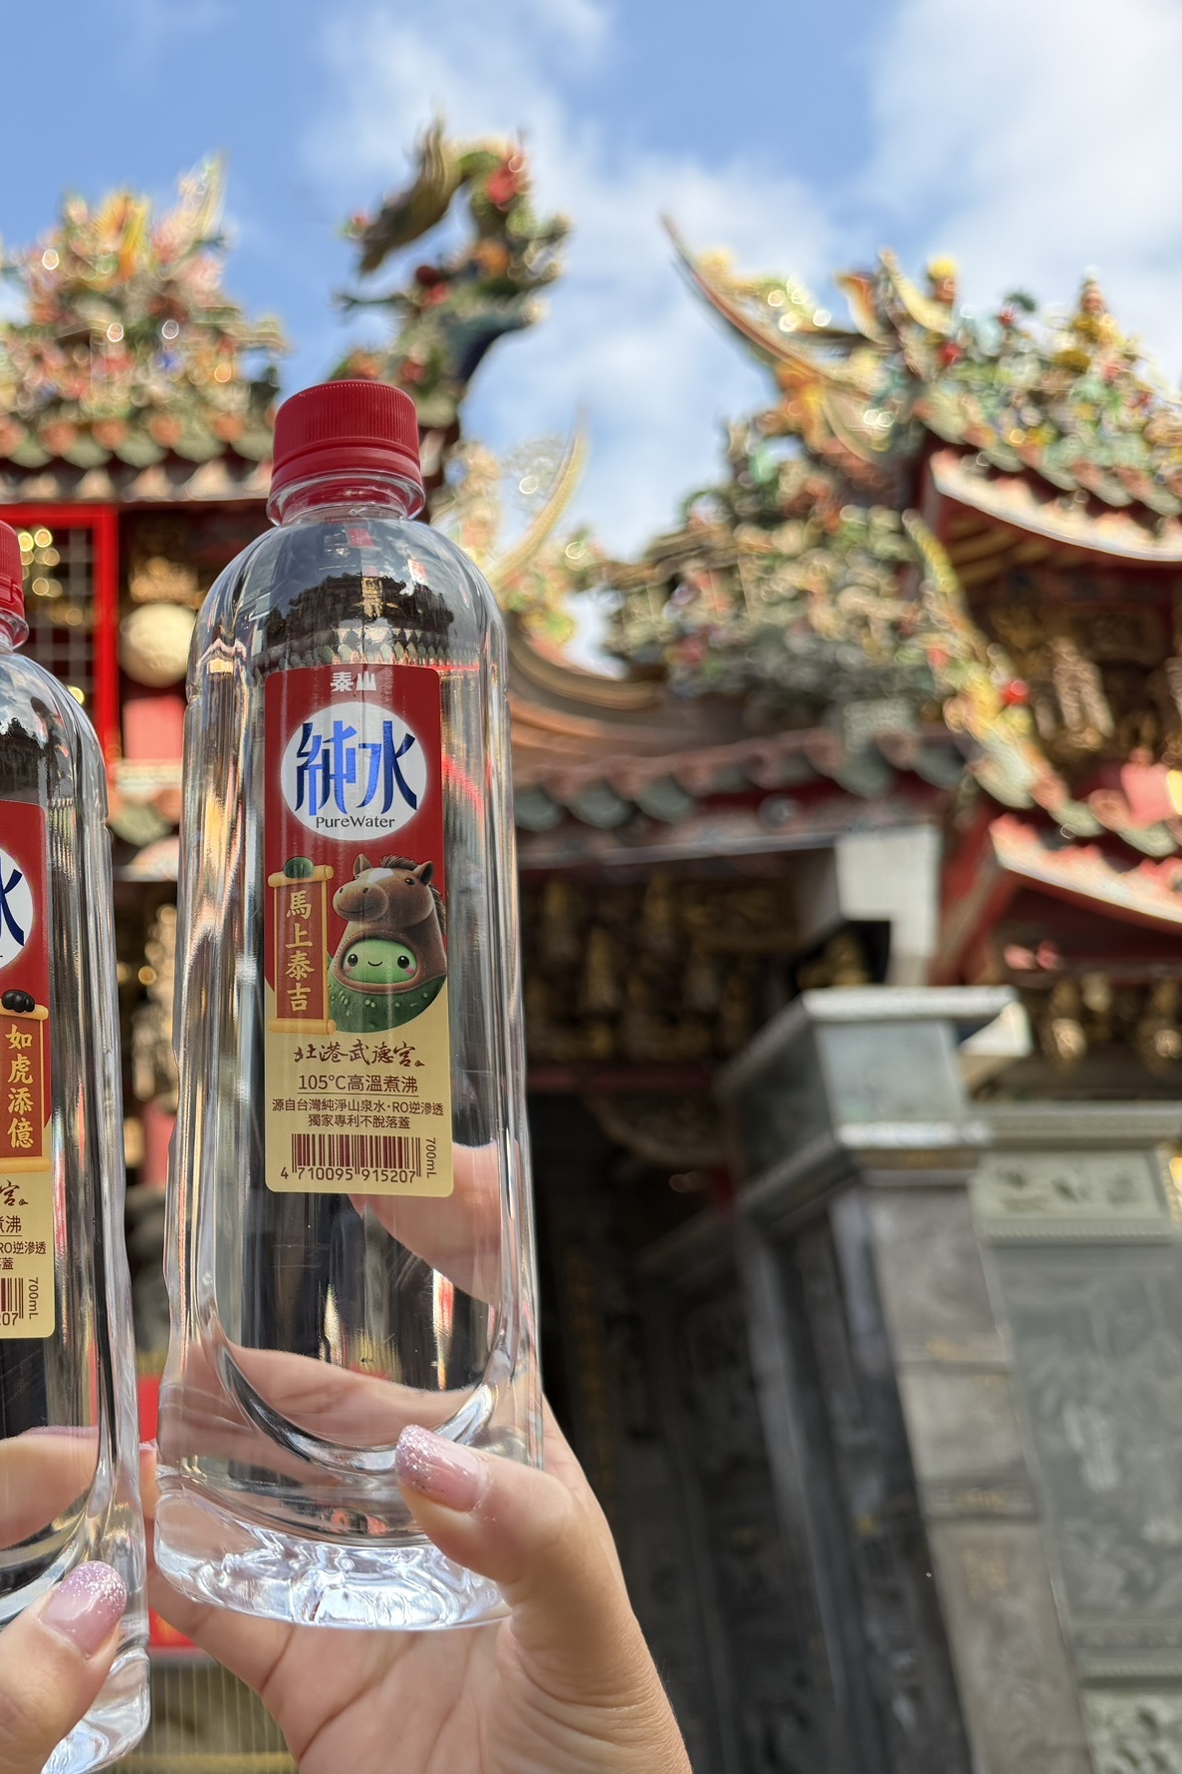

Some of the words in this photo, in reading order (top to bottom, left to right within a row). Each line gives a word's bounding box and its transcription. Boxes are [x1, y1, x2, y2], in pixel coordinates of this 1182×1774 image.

[330, 671, 377, 692] 泰山
[294, 720, 418, 817] 純水
[316, 815, 396, 829] PureWater
[285, 889, 315, 1012] 馬上泰吉
[4, 1023, 34, 1149] 如虎添億
[280, 1166, 289, 1180] 4
[297, 1167, 354, 1181] 710095
[361, 1169, 416, 1184] 915207
[425, 1137, 437, 1179] 700mL
[28, 1276, 39, 1320] 700mL
